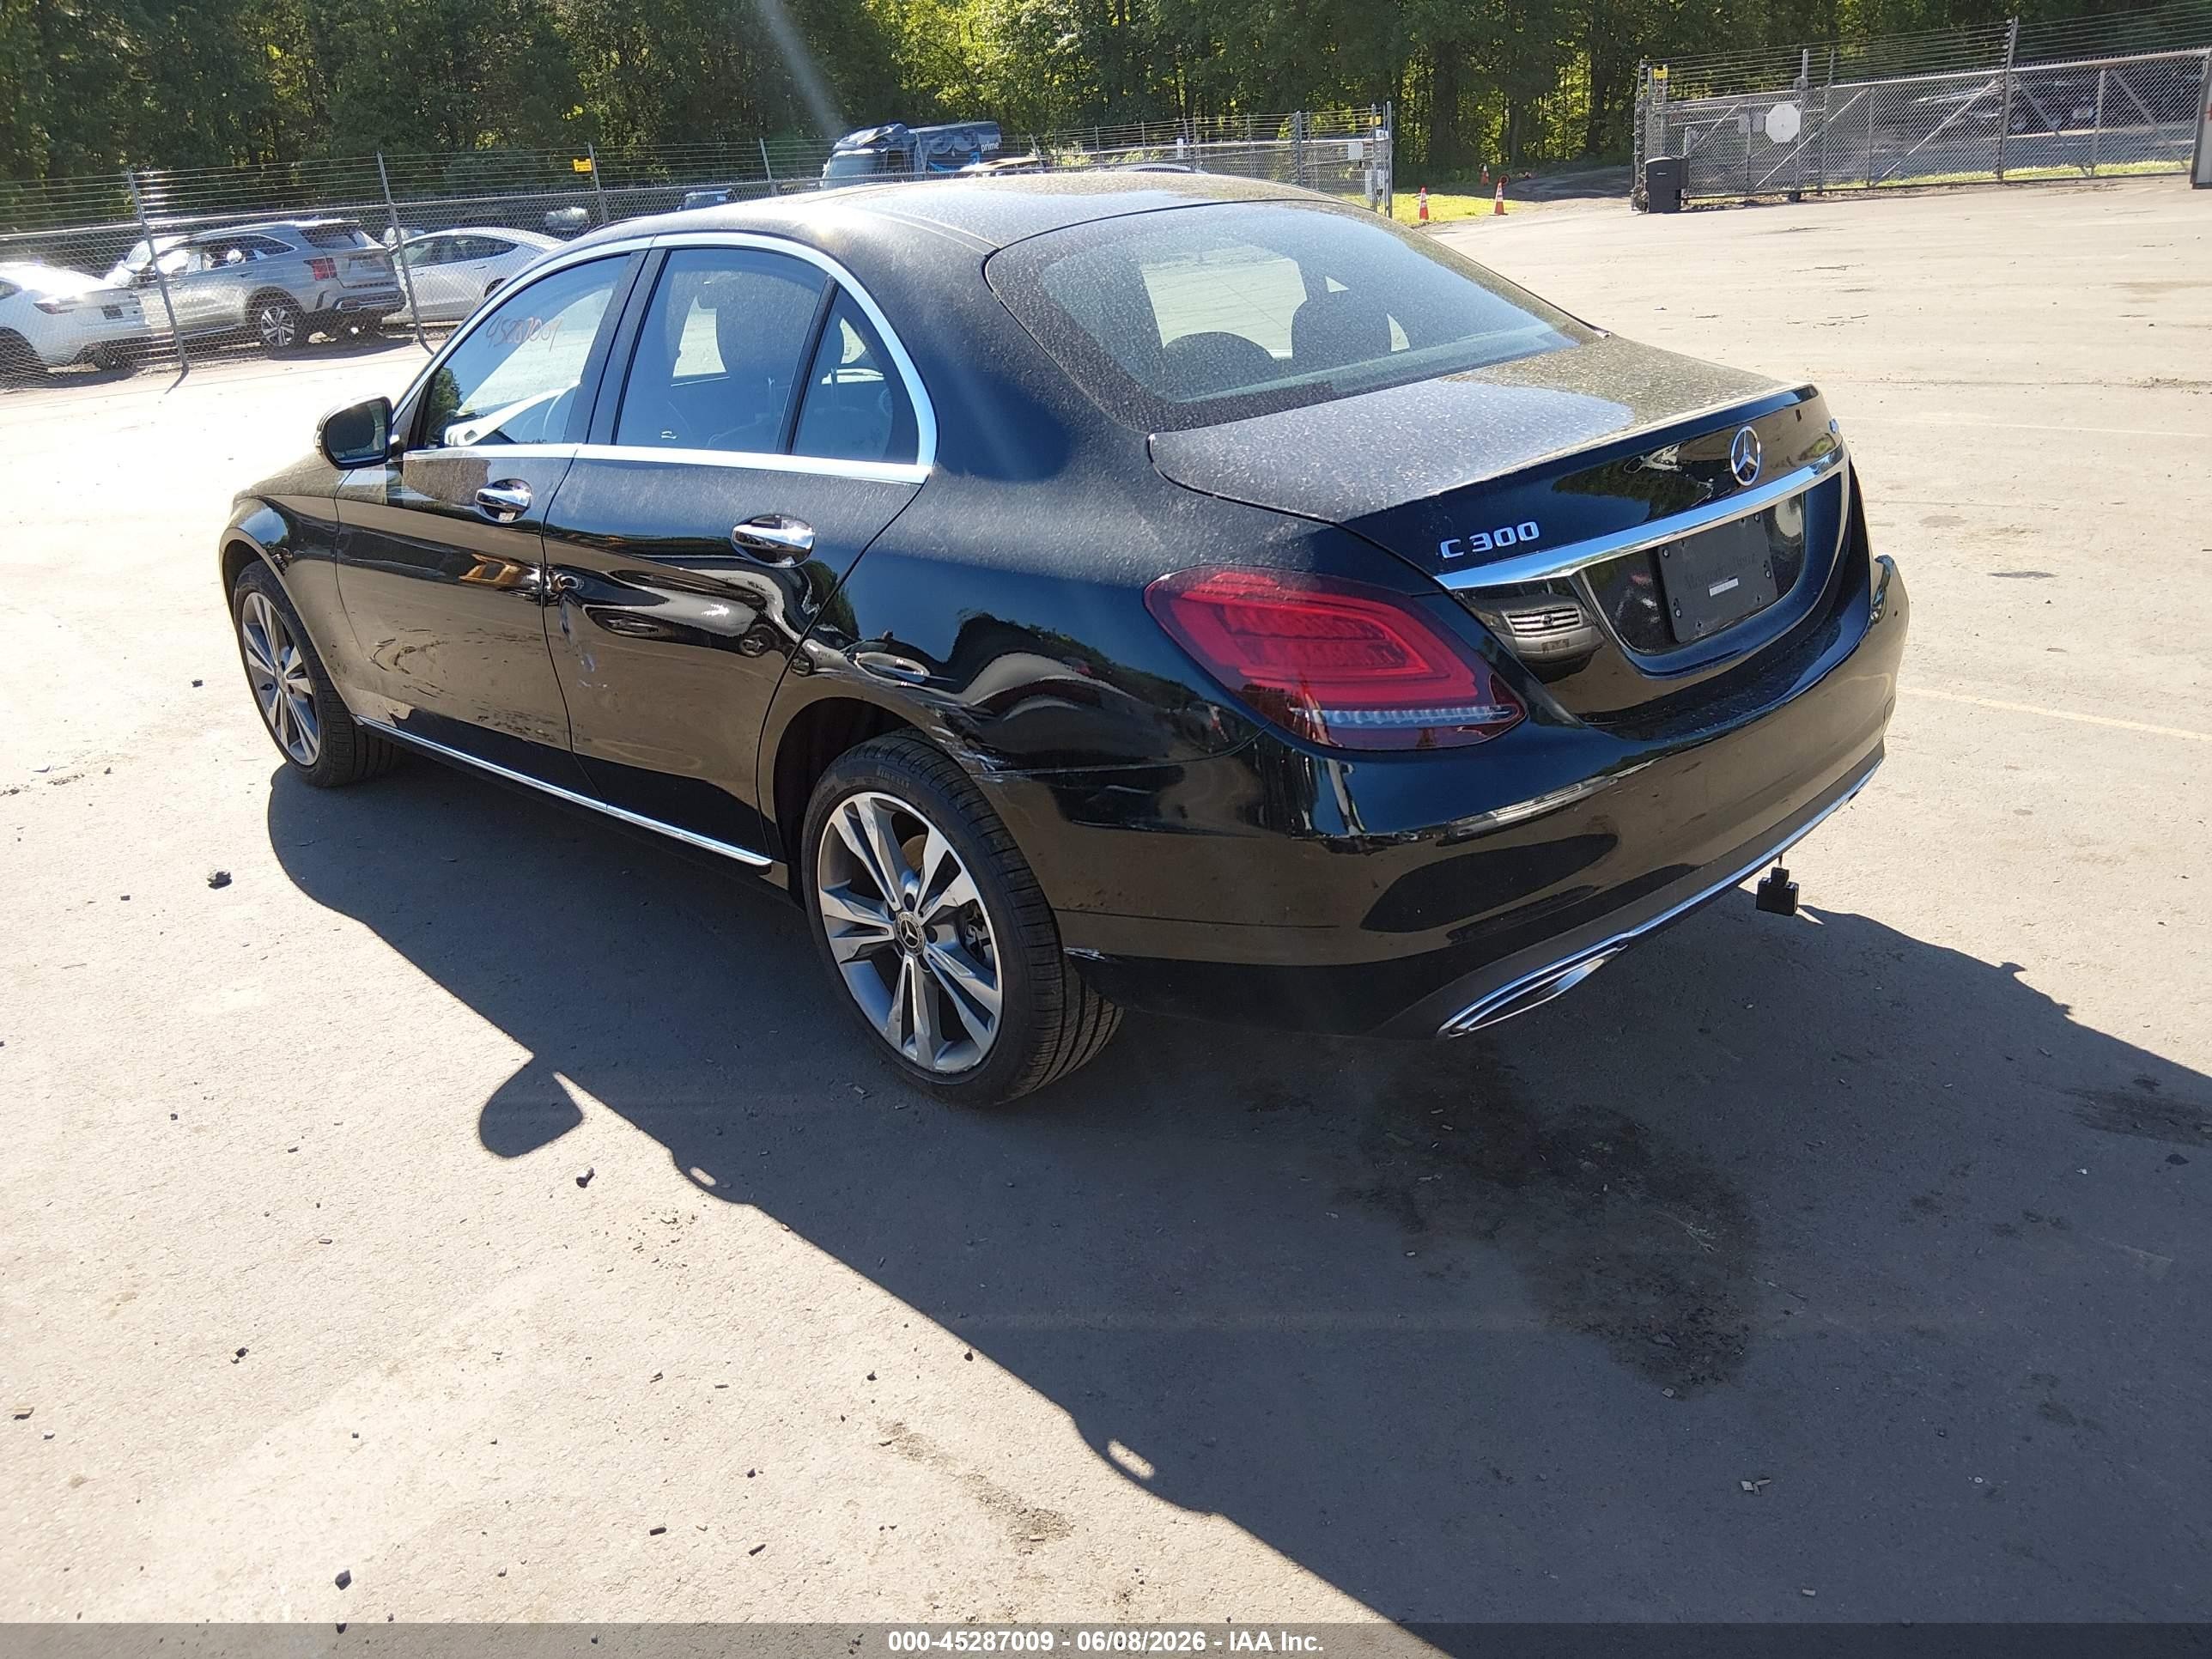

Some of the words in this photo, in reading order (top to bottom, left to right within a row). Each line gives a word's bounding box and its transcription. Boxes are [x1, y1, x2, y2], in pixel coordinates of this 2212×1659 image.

[981, 141, 1000, 155] prime
[1440, 538, 1464, 559] C
[1469, 521, 1540, 552] 300
